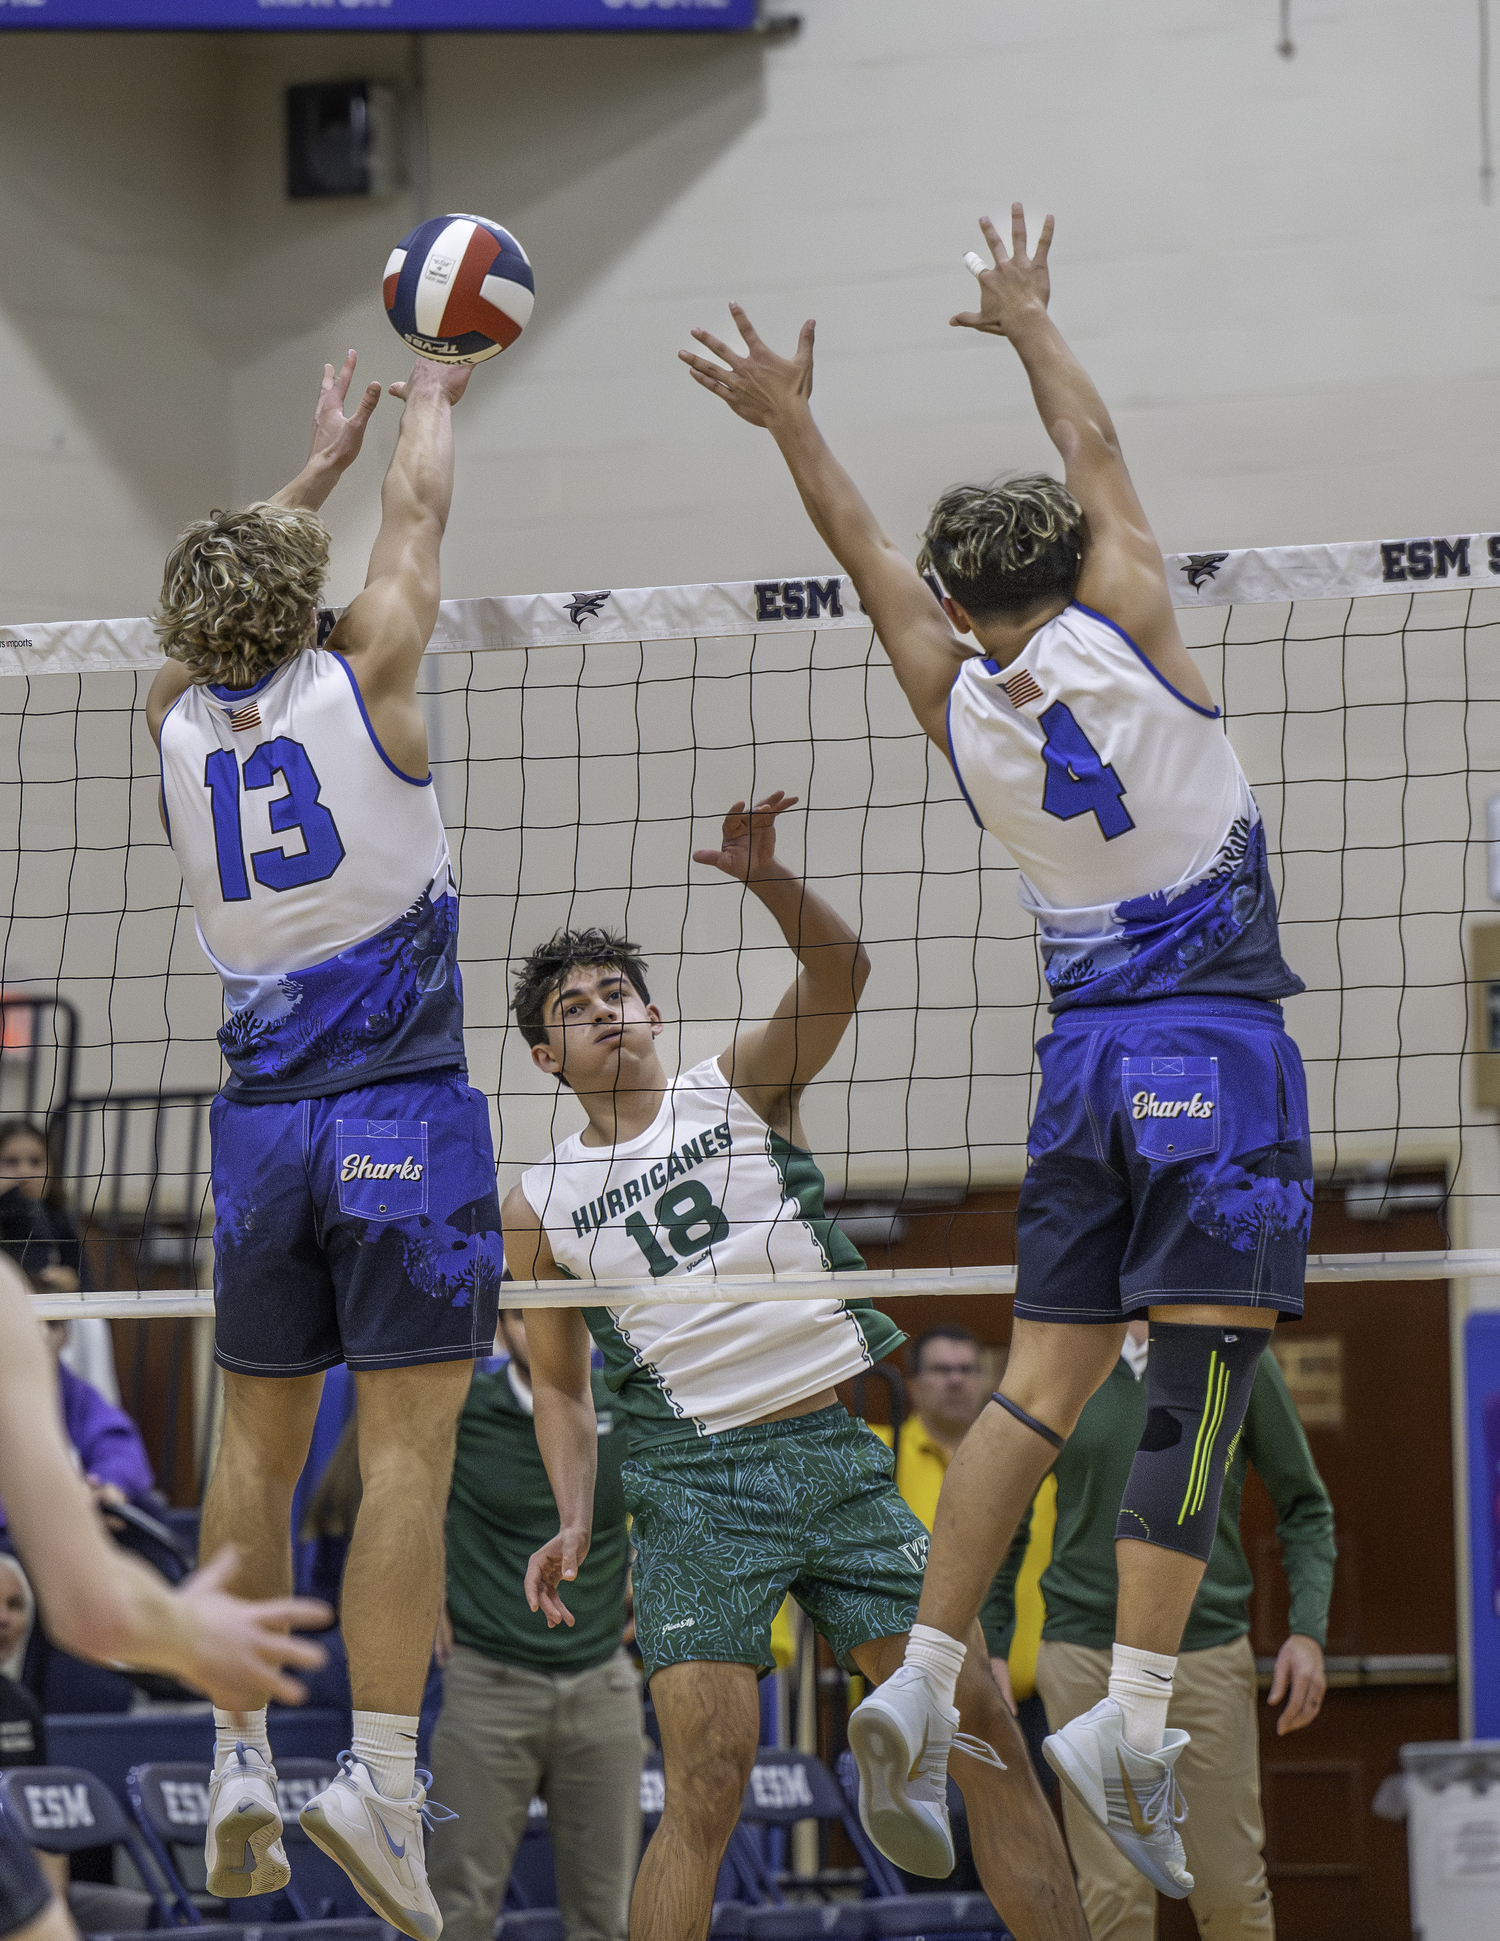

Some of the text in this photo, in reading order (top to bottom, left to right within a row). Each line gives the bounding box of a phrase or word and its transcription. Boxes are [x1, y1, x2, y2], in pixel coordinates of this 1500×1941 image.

[1380, 537, 1471, 582] ESM
[754, 578, 844, 622] ESM
[1037, 699, 1136, 842] 4
[204, 735, 346, 902] 13
[1132, 1091, 1215, 1119] Sharks
[340, 1153, 424, 1182] Sharks
[571, 1122, 733, 1239] HURRICANES
[624, 1179, 730, 1278] 18
[24, 1783, 95, 1829] ESM
[751, 1763, 813, 1808] ESM
